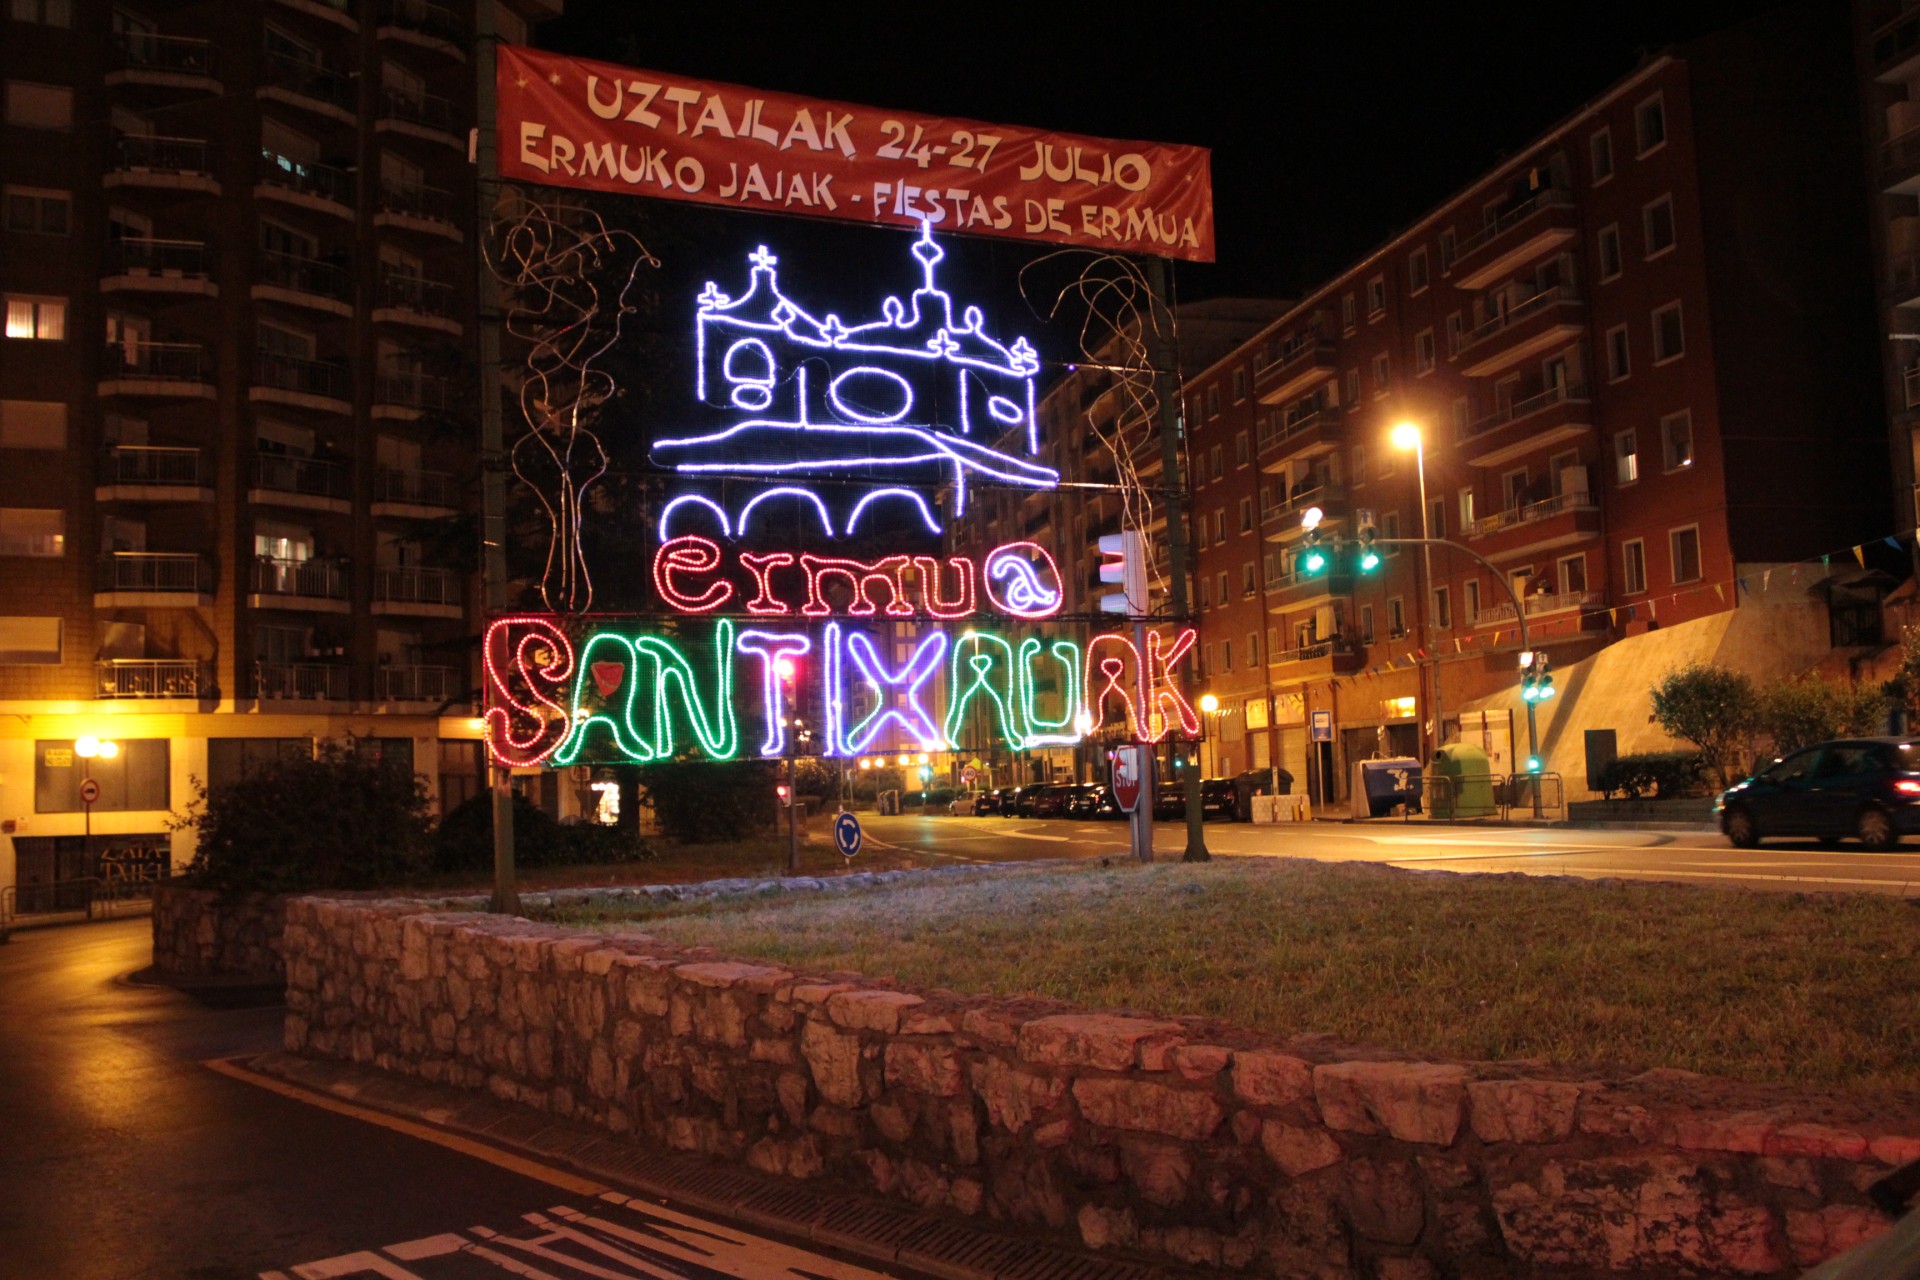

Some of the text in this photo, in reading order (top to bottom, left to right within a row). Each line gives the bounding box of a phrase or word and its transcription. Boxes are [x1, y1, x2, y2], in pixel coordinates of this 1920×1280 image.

[520, 121, 706, 193] ERMUKO
[719, 162, 838, 211] JAIAK
[873, 178, 1013, 230] FIESTAS
[1025, 198, 1072, 236] DE
[1081, 204, 1200, 249] ERMUA
[587, 75, 1151, 192] UZTAILAK 24-27 JULIO
